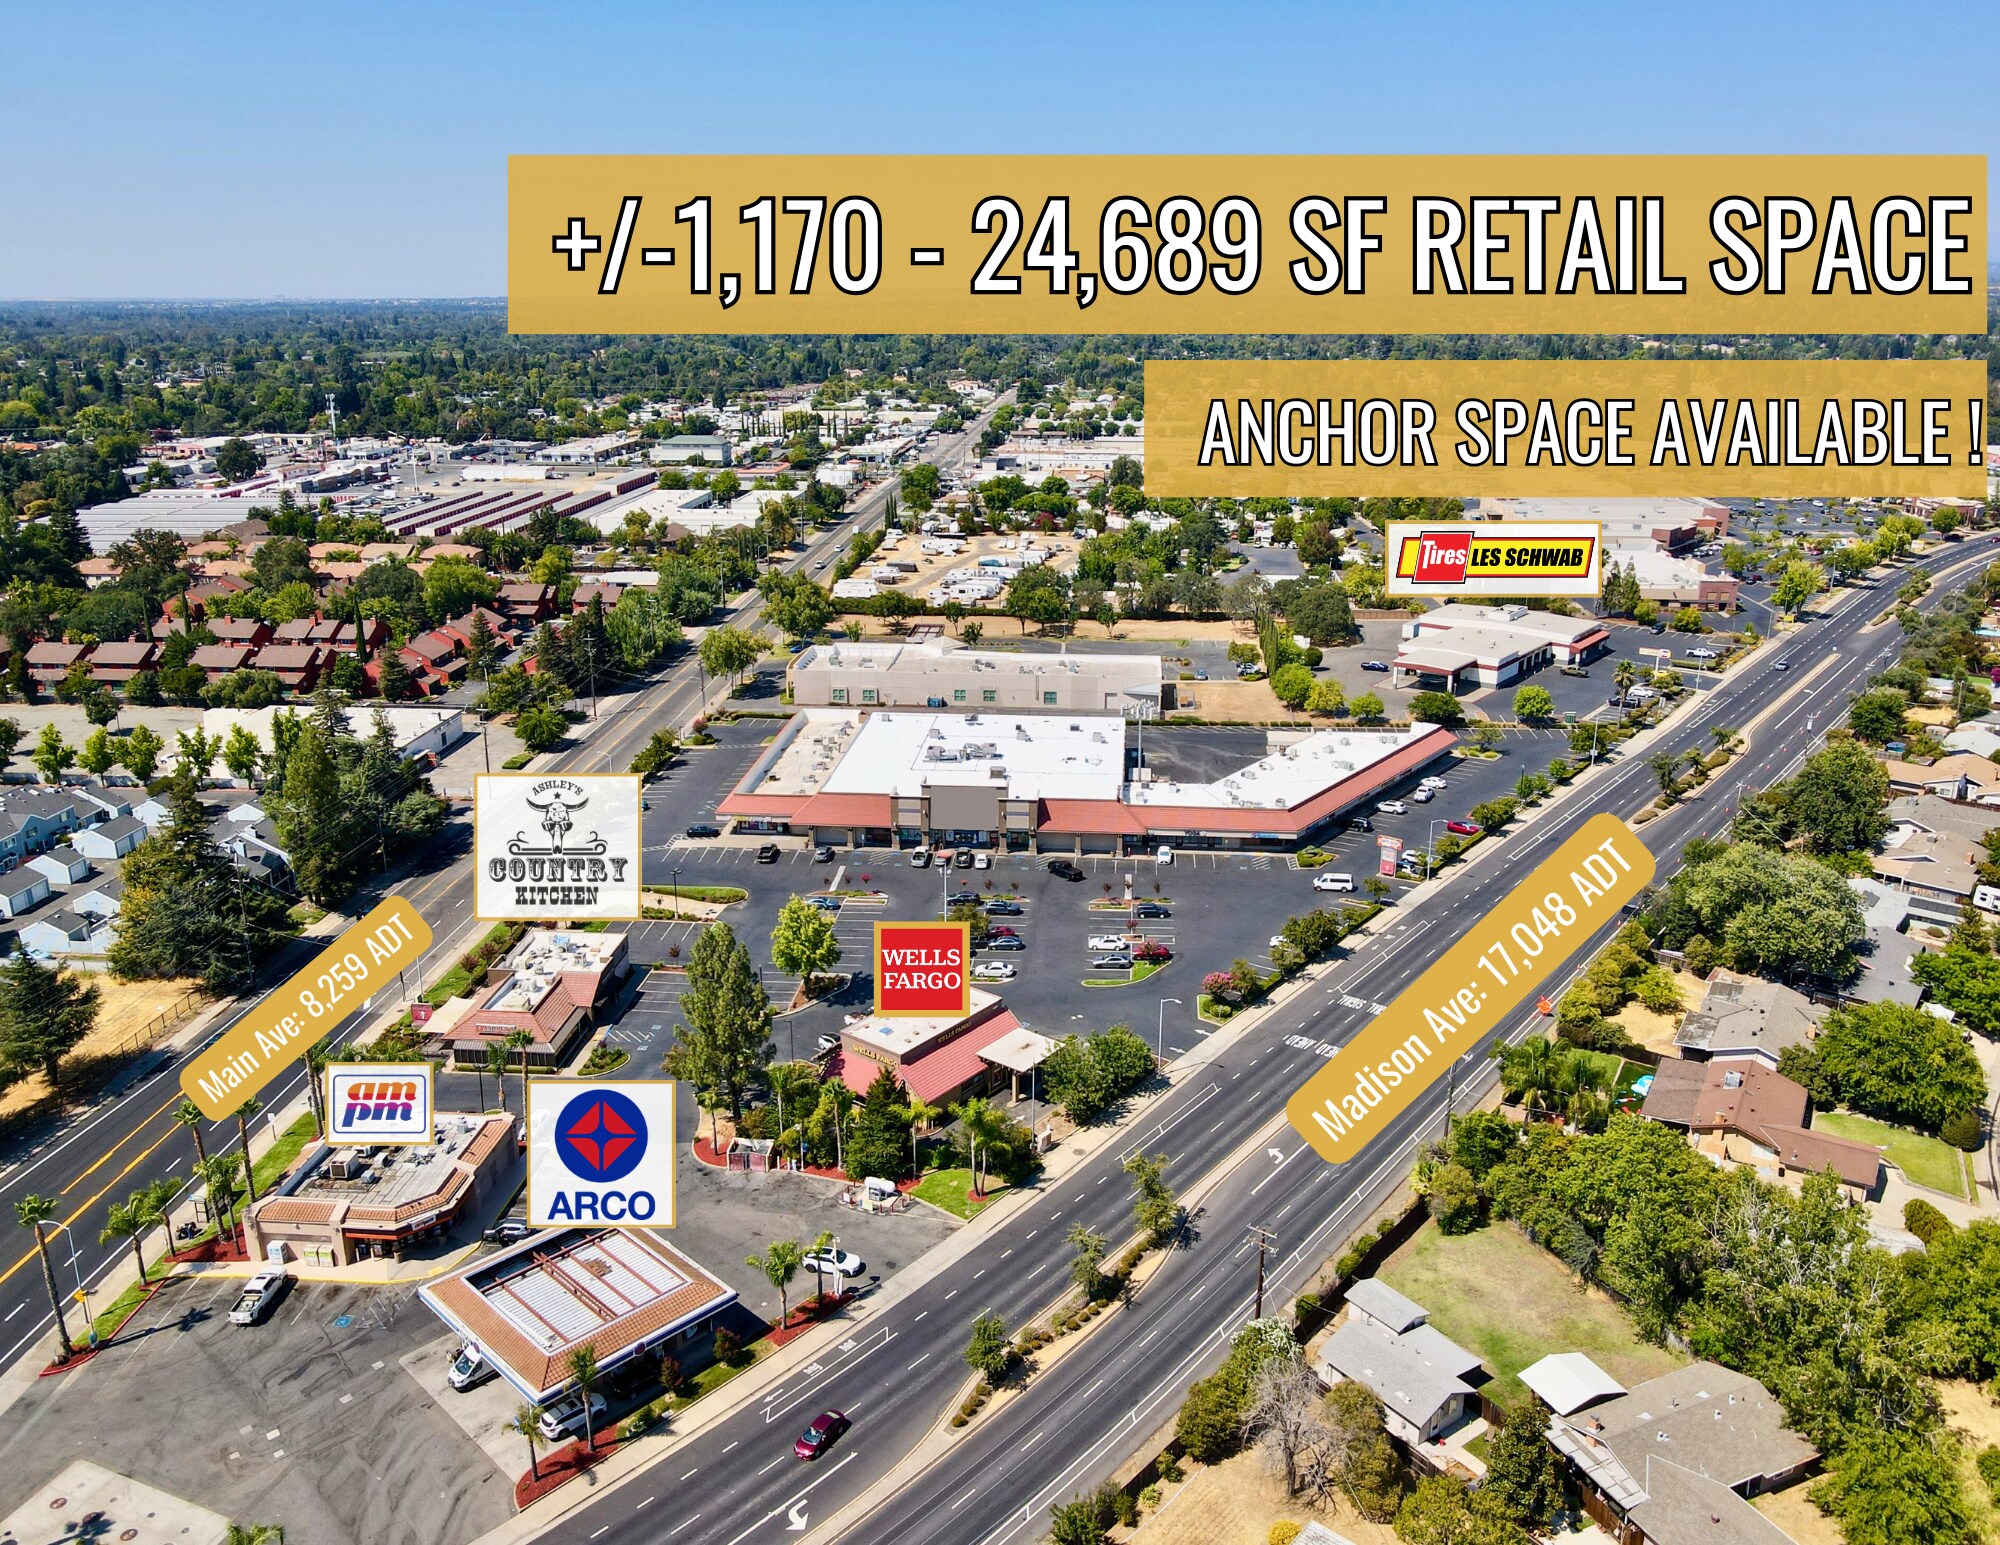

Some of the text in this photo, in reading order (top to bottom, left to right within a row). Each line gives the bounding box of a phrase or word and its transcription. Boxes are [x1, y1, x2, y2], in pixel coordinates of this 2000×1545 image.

[937, 1021, 972, 1044] WELLS FARGO
[852, 1044, 899, 1068] WELLS FARGO
